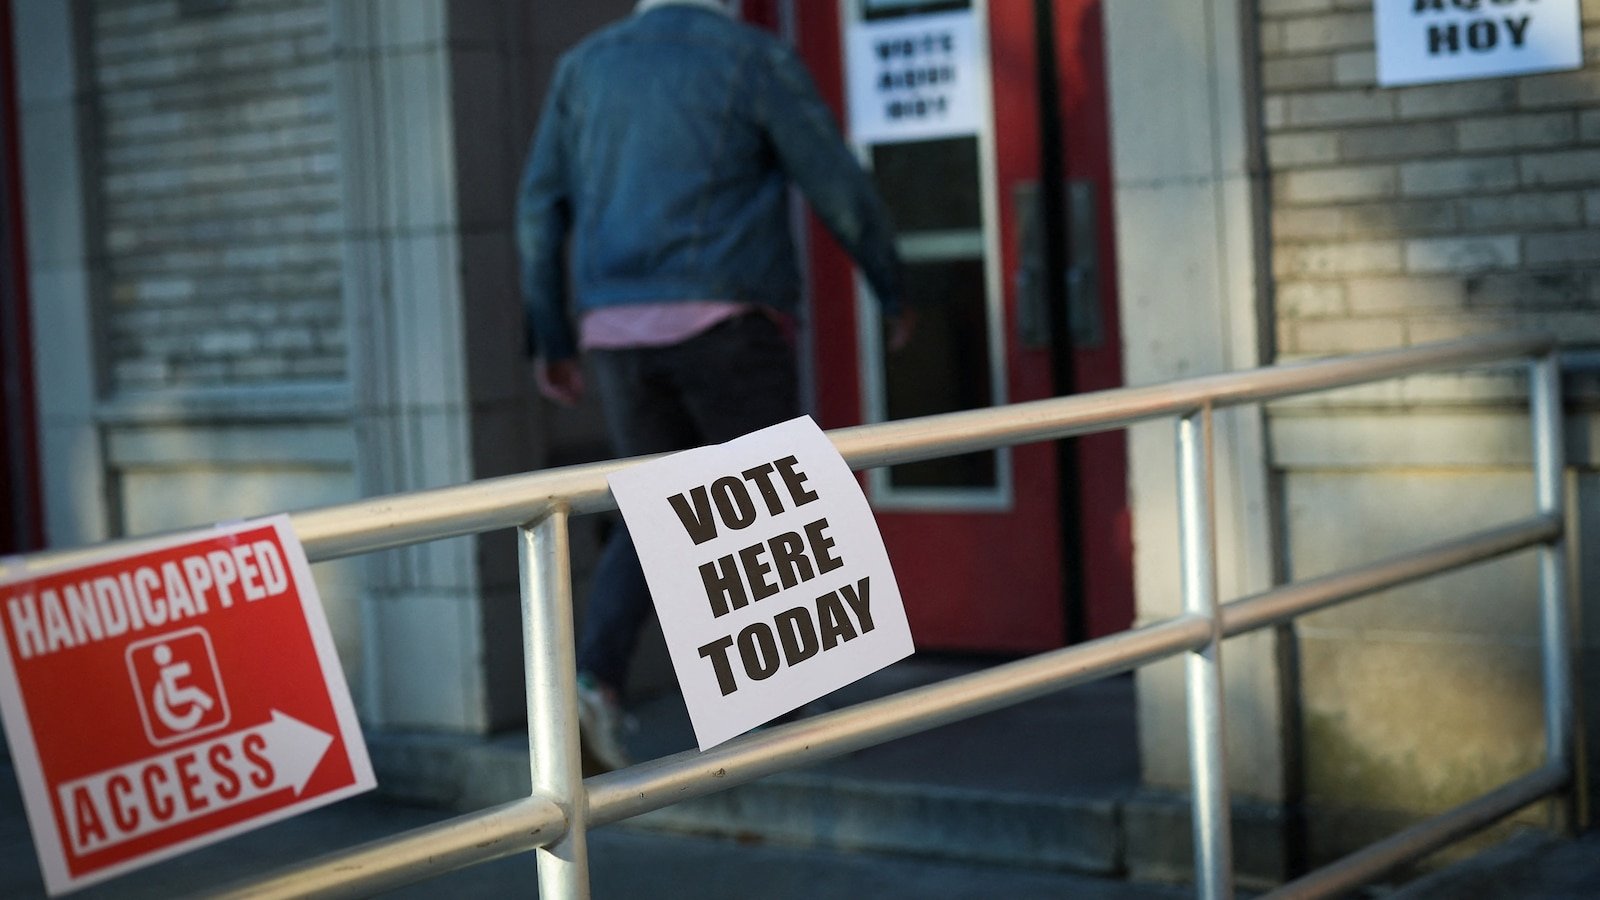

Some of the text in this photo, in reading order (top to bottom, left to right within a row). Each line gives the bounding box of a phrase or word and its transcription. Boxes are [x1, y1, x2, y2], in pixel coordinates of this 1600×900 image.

[1427, 16, 1530, 54] HOY
[667, 455, 819, 546] VOTE
[6, 539, 289, 660] HANDICAPPED
[698, 518, 844, 619] HERE
[697, 576, 875, 697] TODAY
[73, 733, 276, 847] ACCESS
